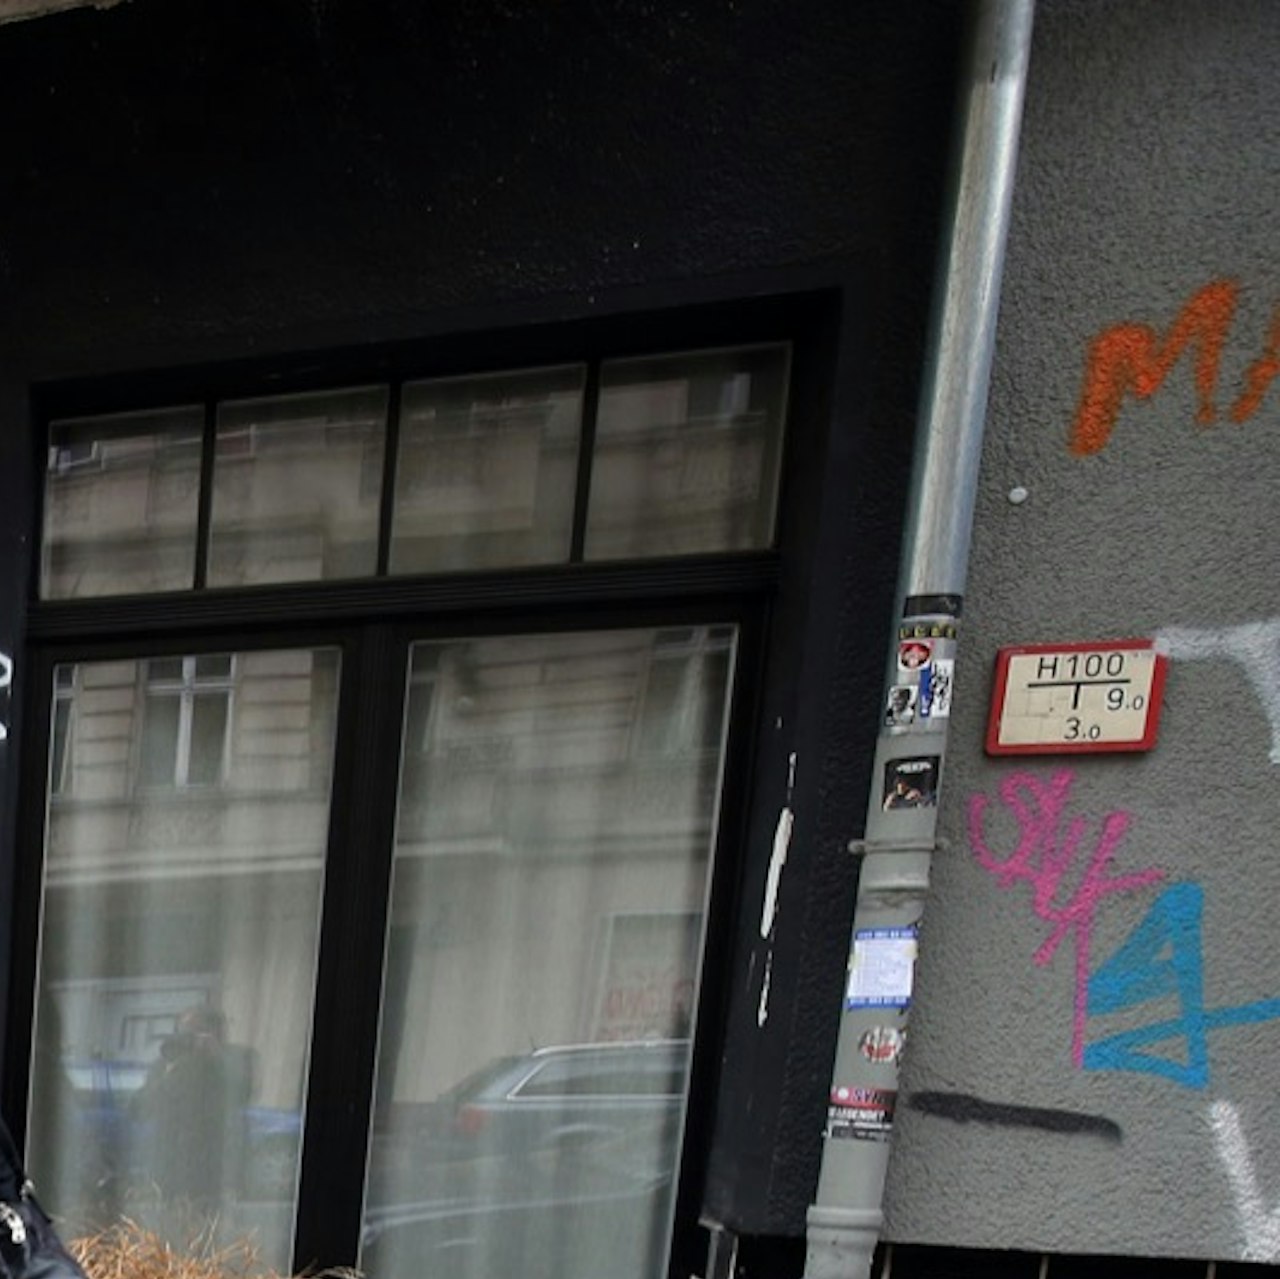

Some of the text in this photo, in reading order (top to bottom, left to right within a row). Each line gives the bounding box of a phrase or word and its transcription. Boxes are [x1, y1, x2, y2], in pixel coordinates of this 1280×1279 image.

[1037, 653, 1124, 679] H100
[1107, 687, 1144, 711] 9.0
[1064, 716, 1101, 740] 3.0
